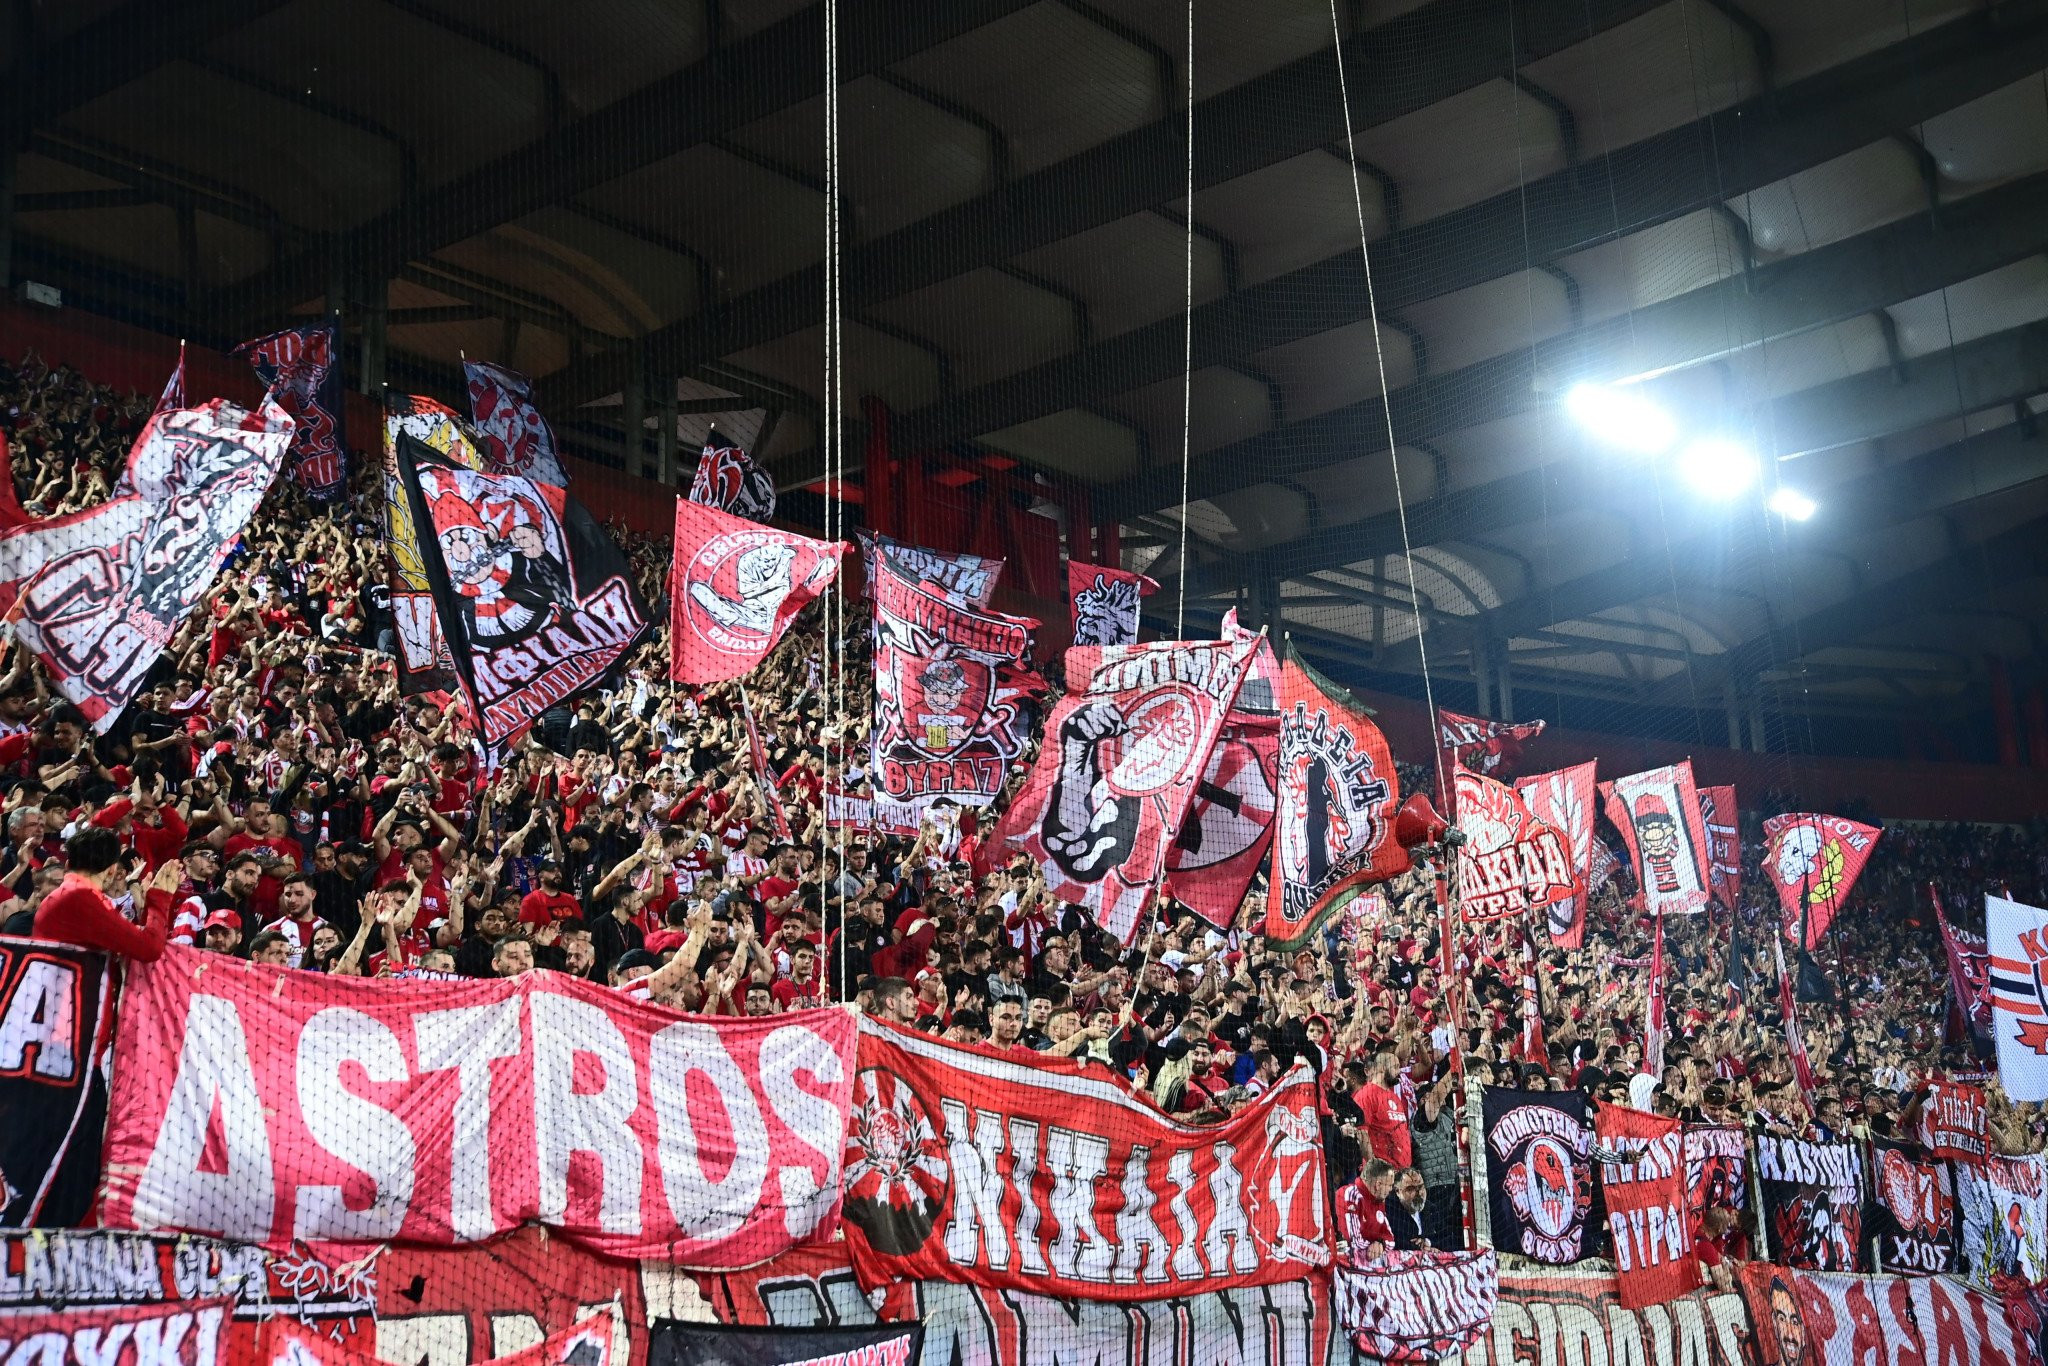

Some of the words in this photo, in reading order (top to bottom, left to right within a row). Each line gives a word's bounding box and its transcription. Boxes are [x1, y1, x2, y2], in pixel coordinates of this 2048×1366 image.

[884, 758, 977, 796] ΘΥΡΑ
[980, 756, 1003, 794] 7
[131, 990, 845, 1243] ASTROS
[942, 1098, 1258, 1285] ΝΙΚΑΙΑ
[175, 1239, 269, 1301] CLUB
[1890, 1236, 1950, 1272] ΧΙΟΣ
